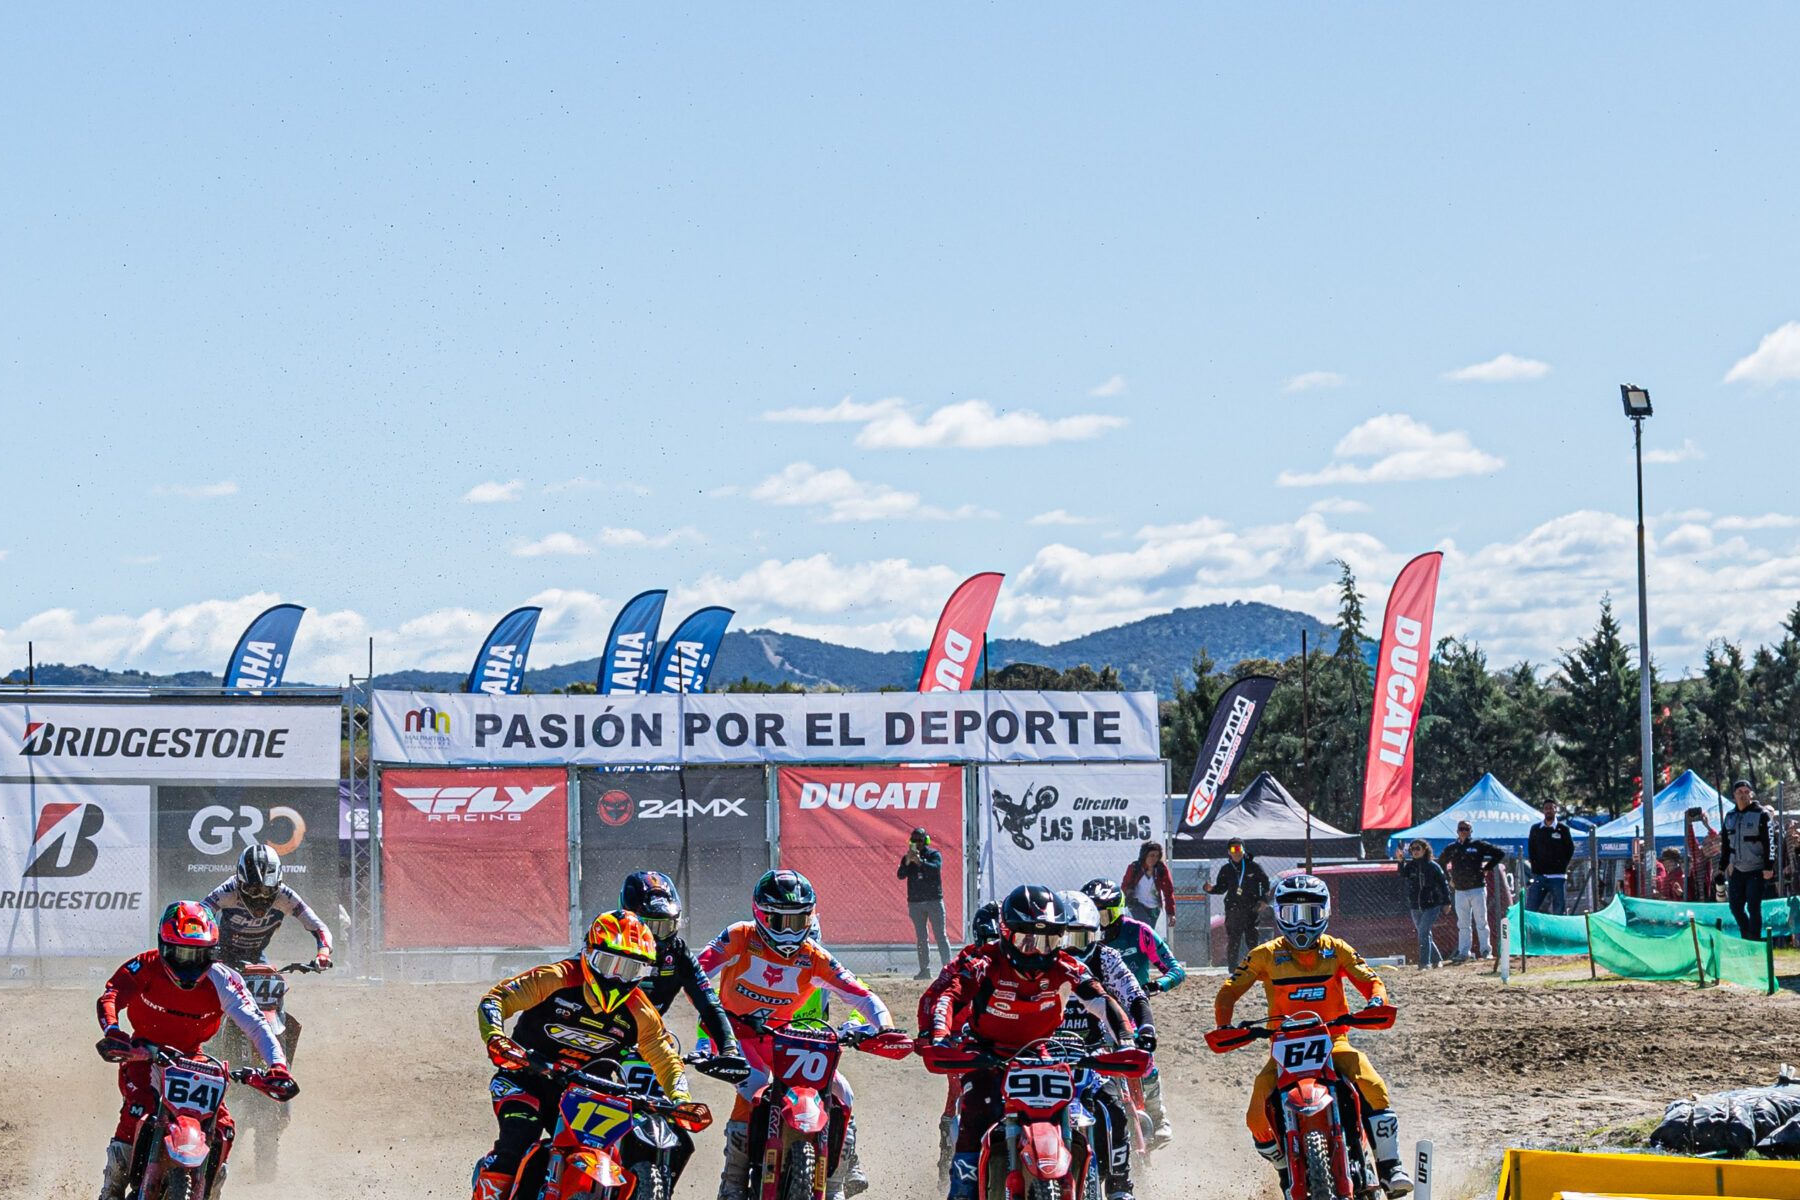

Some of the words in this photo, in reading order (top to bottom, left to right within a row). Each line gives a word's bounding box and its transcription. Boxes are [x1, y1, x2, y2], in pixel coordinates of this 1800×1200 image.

[1380, 614, 1423, 766] DUCATI
[20, 722, 289, 759] BRIDGESTONE
[475, 706, 662, 748] PASIÓN
[685, 712, 786, 748] POR
[806, 712, 865, 747] EL
[886, 709, 1122, 746] DEPORTE
[396, 786, 556, 814] FLY
[638, 797, 748, 819] 24MX
[800, 782, 941, 810] DUCATI
[1073, 796, 1129, 811] Circuito
[428, 813, 522, 822] RACING
[1040, 815, 1072, 842] LAS
[1081, 815, 1152, 841] ARENAS
[1467, 811, 1531, 822] YAMAHA
[736, 983, 793, 1006] HONDA
[558, 1048, 593, 1062] KTM
[782, 1049, 828, 1082] 70
[1284, 1038, 1327, 1069] 64
[1008, 1073, 1072, 1098] 96
[569, 1101, 630, 1139] 17
[1417, 1151, 1428, 1184] UFO
